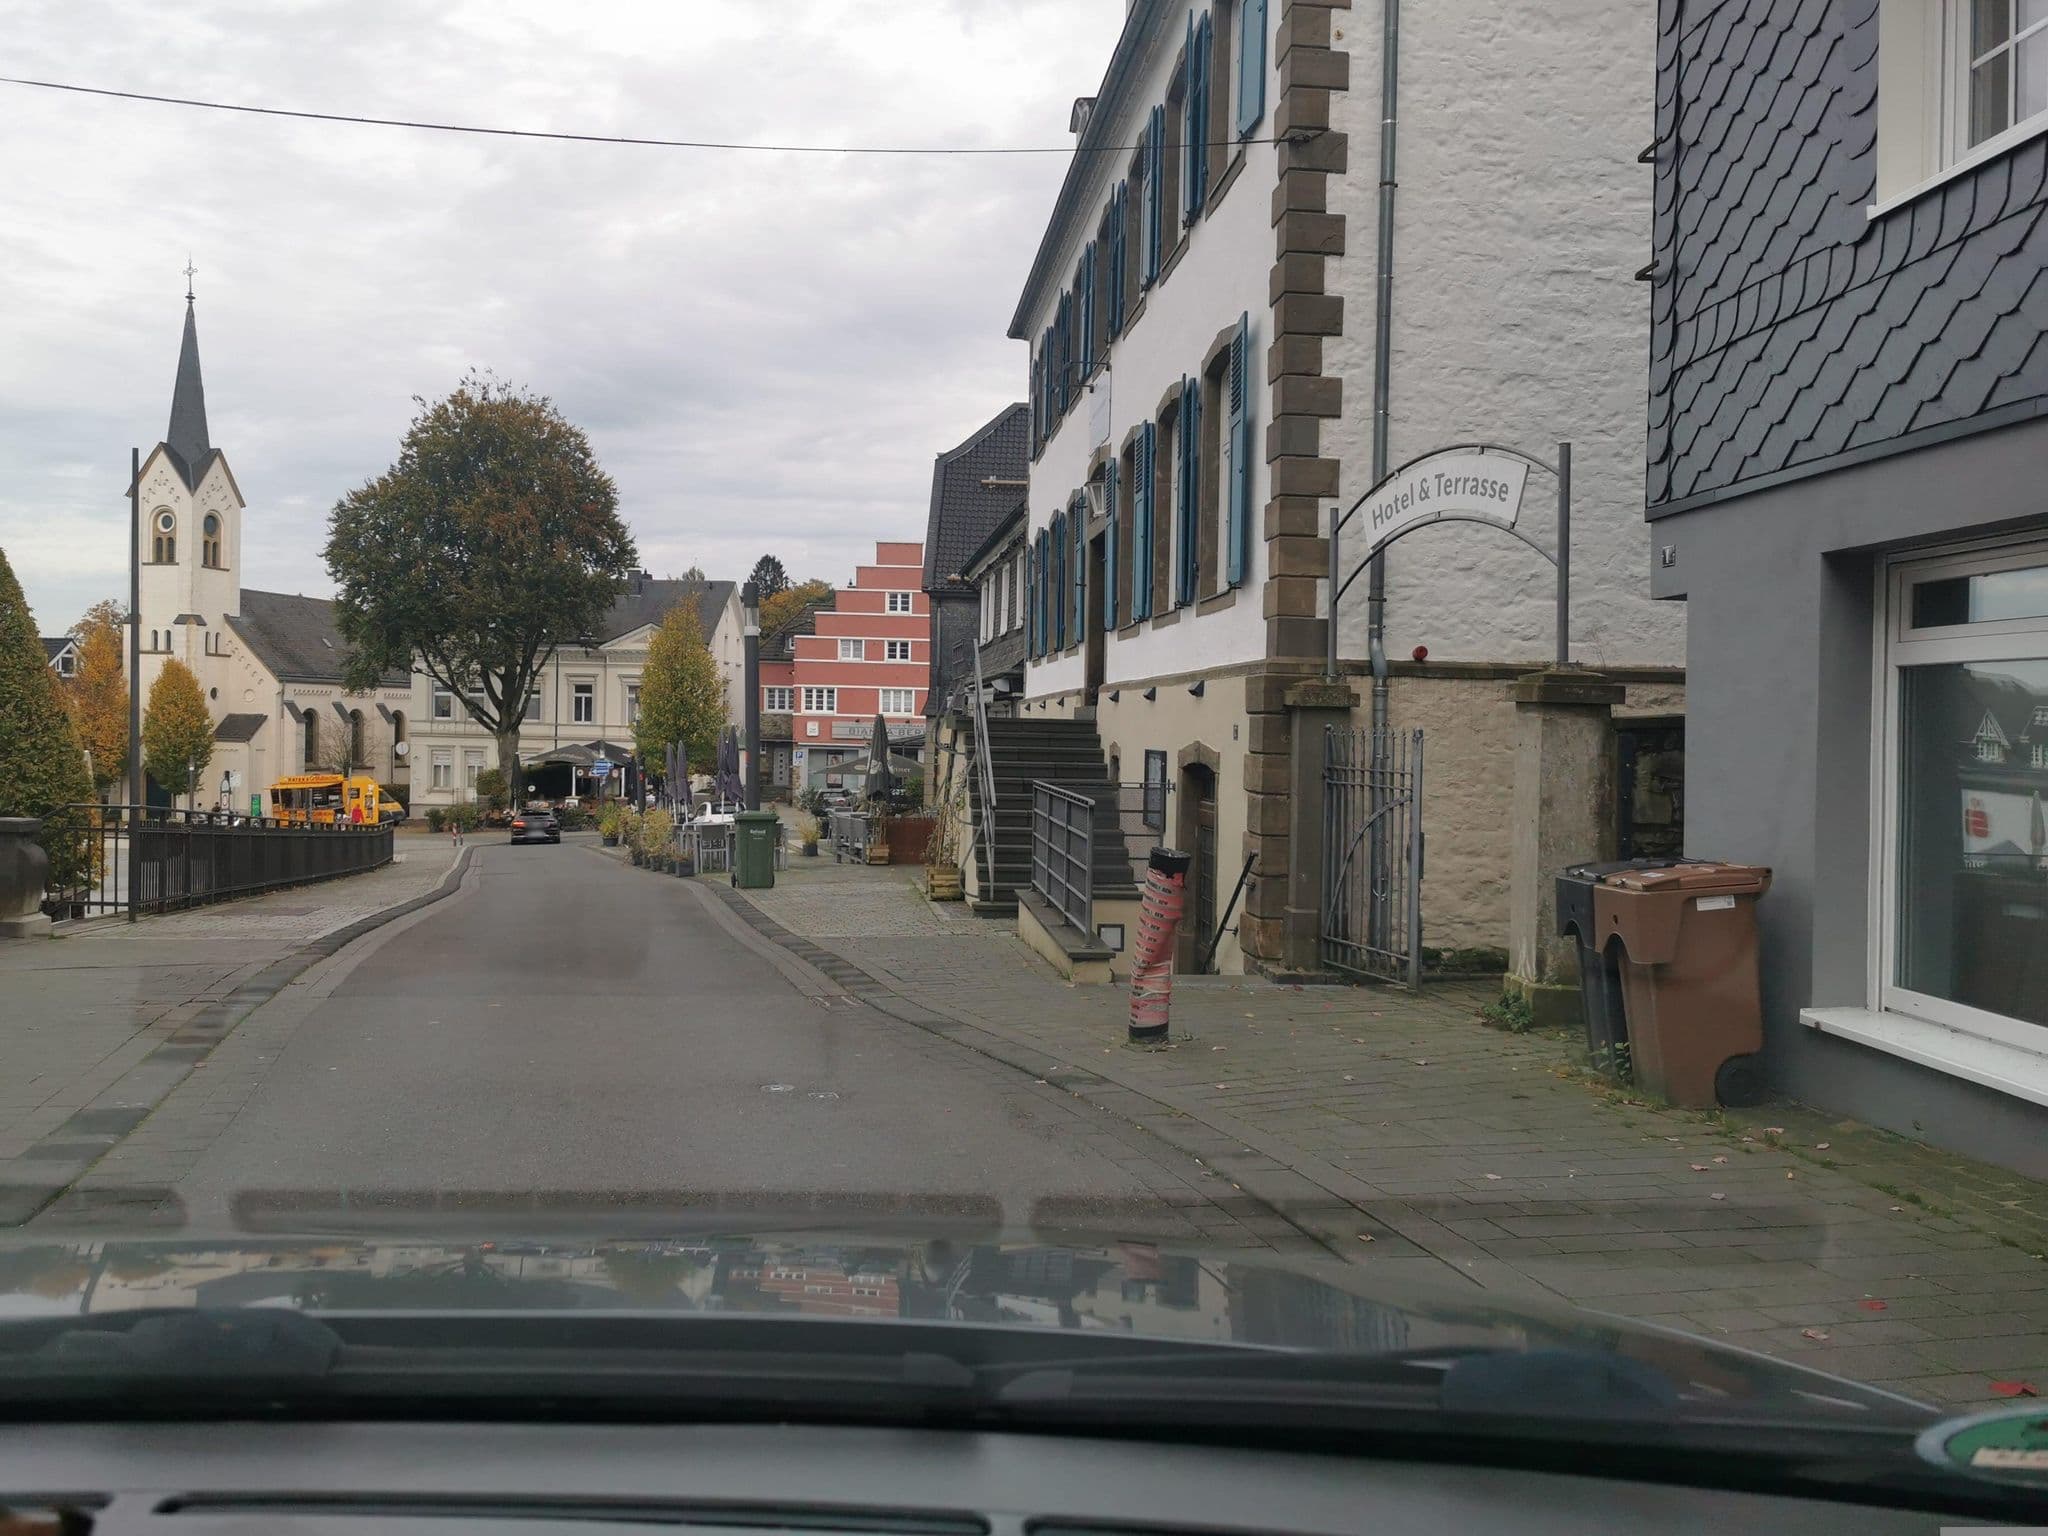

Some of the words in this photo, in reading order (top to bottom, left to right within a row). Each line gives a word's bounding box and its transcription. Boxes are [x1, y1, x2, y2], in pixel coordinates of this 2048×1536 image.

[1372, 482, 1414, 530] Hotel
[1419, 477, 1431, 502] &
[1434, 472, 1509, 502] Terrasse
